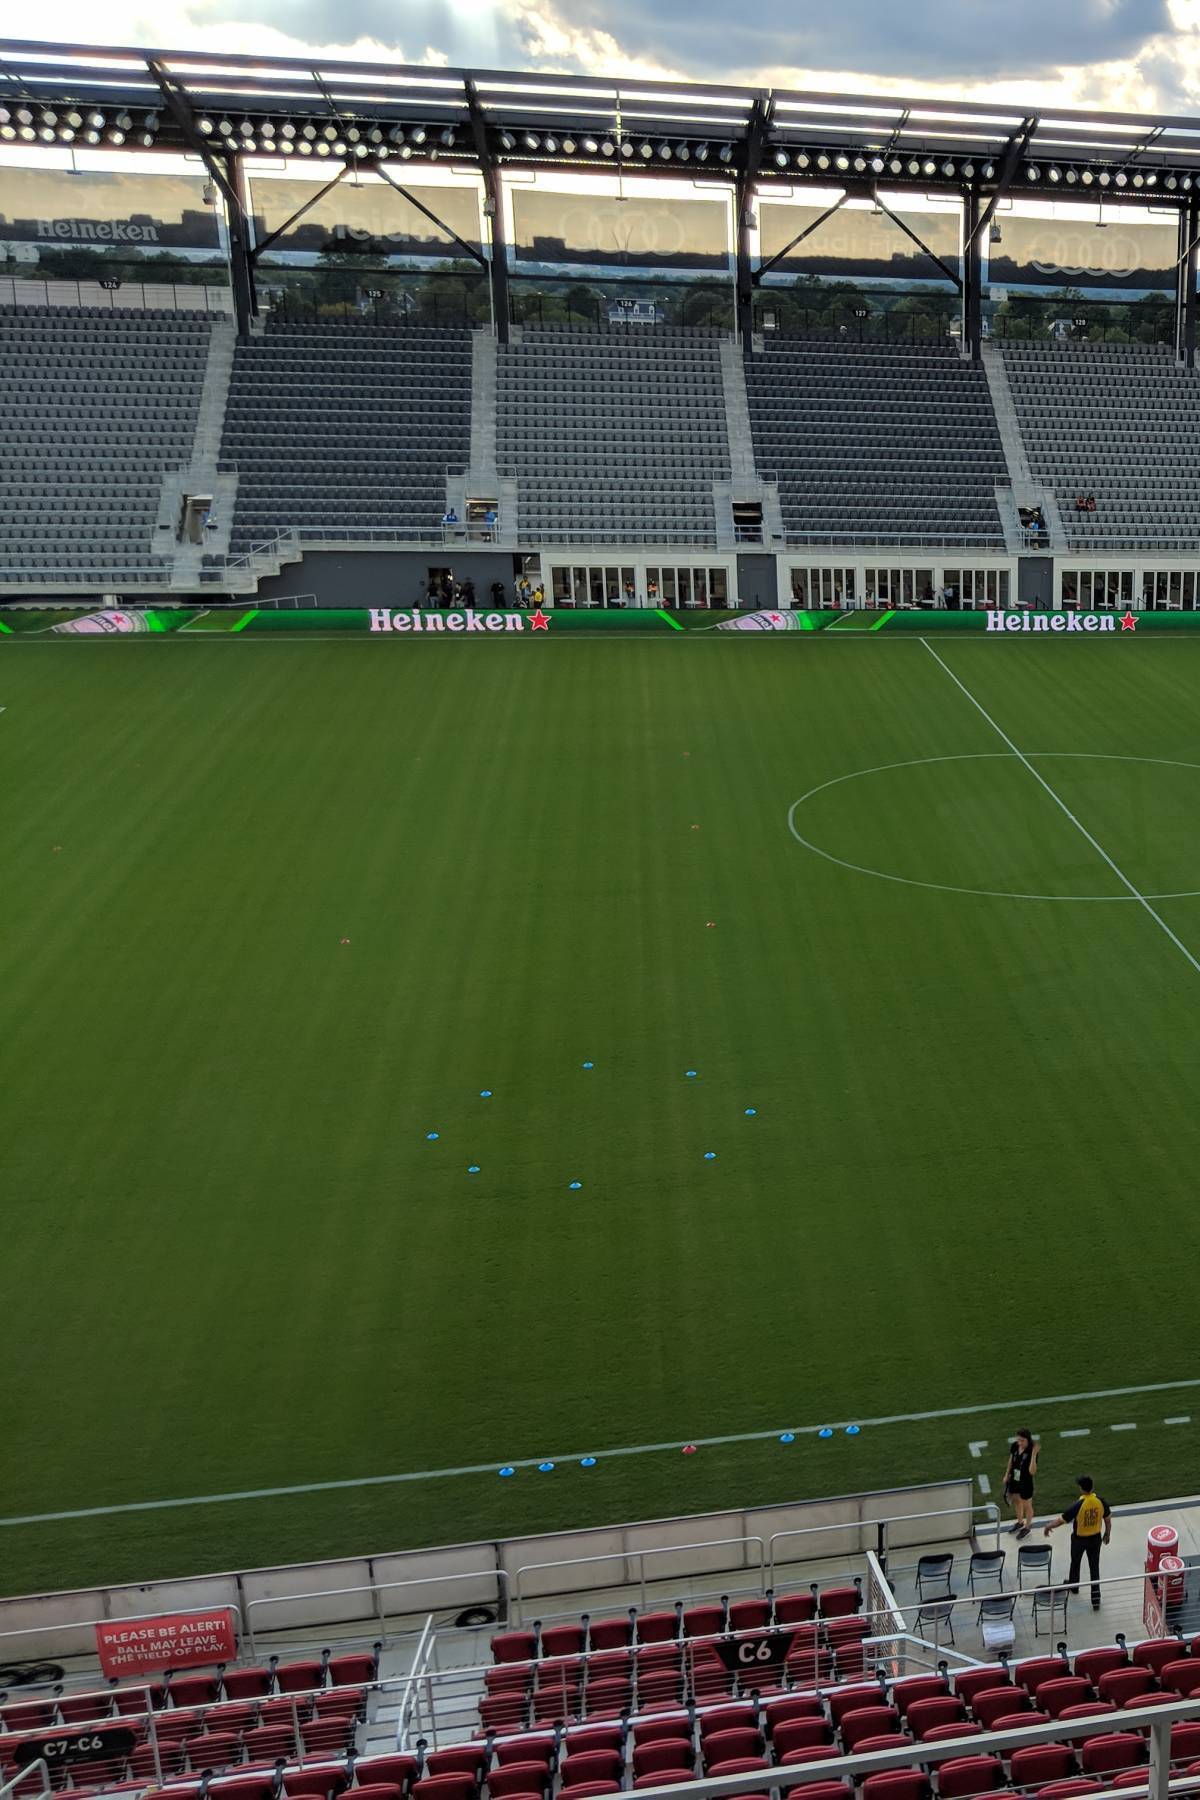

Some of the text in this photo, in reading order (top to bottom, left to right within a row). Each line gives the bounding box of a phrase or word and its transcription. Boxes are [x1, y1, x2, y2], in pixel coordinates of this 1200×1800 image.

[37, 217, 160, 242] Heineken
[104, 280, 117, 289] 124
[368, 290, 382, 298] 125
[368, 609, 524, 632] Heineken
[986, 610, 1115, 632] Heineken
[103, 1620, 226, 1644] PLEASE BE ALERT!
[117, 1634, 217, 1654] BALL MAY LEAVE
[738, 1640, 772, 1663] C6
[110, 1654, 135, 1666] THE
[137, 1650, 171, 1661] FIELD
[174, 1647, 192, 1656] OF
[43, 1736, 104, 1757] C7-C6
